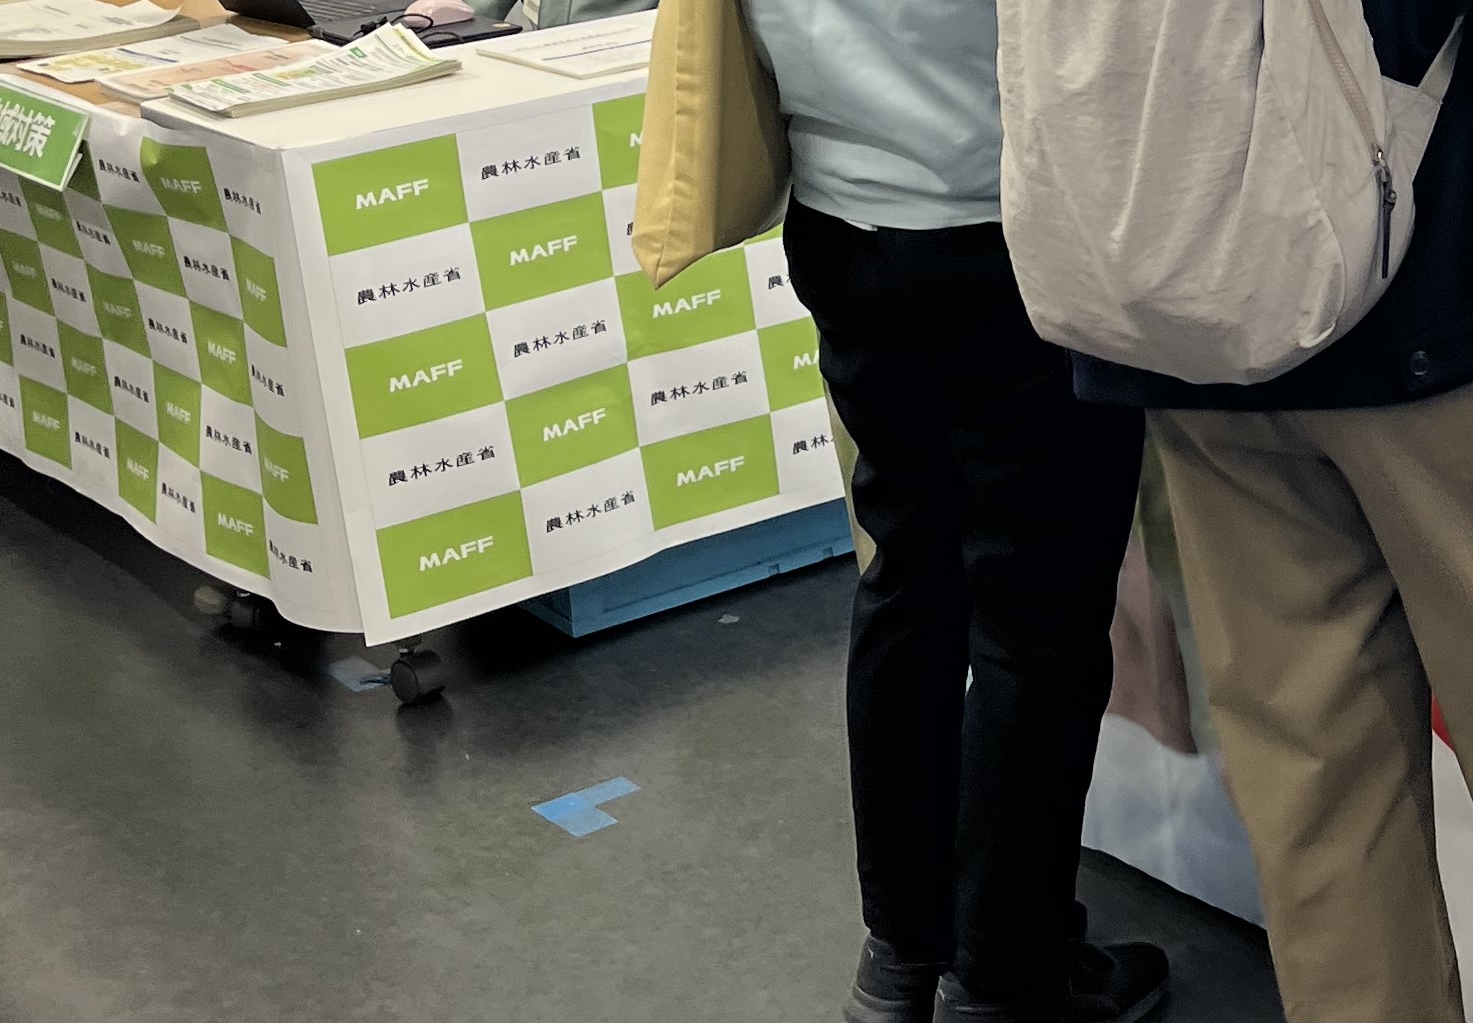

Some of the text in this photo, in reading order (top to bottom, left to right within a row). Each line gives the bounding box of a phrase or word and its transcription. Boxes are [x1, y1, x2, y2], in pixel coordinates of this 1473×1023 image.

[480, 145, 582, 181] 農林水産省
[160, 176, 202, 194] MAFF
[355, 179, 430, 210] MAFF
[509, 235, 578, 265] MAFF
[357, 267, 462, 306] 農林水産省
[652, 289, 722, 319] MAFF
[513, 319, 608, 358] 農林水産省
[389, 359, 463, 393] MAFF
[650, 371, 748, 406] 農林水産省
[205, 425, 252, 454] 農林水産省
[542, 407, 606, 442] MAFF
[793, 435, 834, 455] 農林
[388, 445, 496, 488] 農林水産省
[676, 456, 745, 487] MAFF
[217, 512, 254, 536] MAFF
[545, 490, 636, 534] 農林水産省
[418, 536, 495, 571] MAFF
